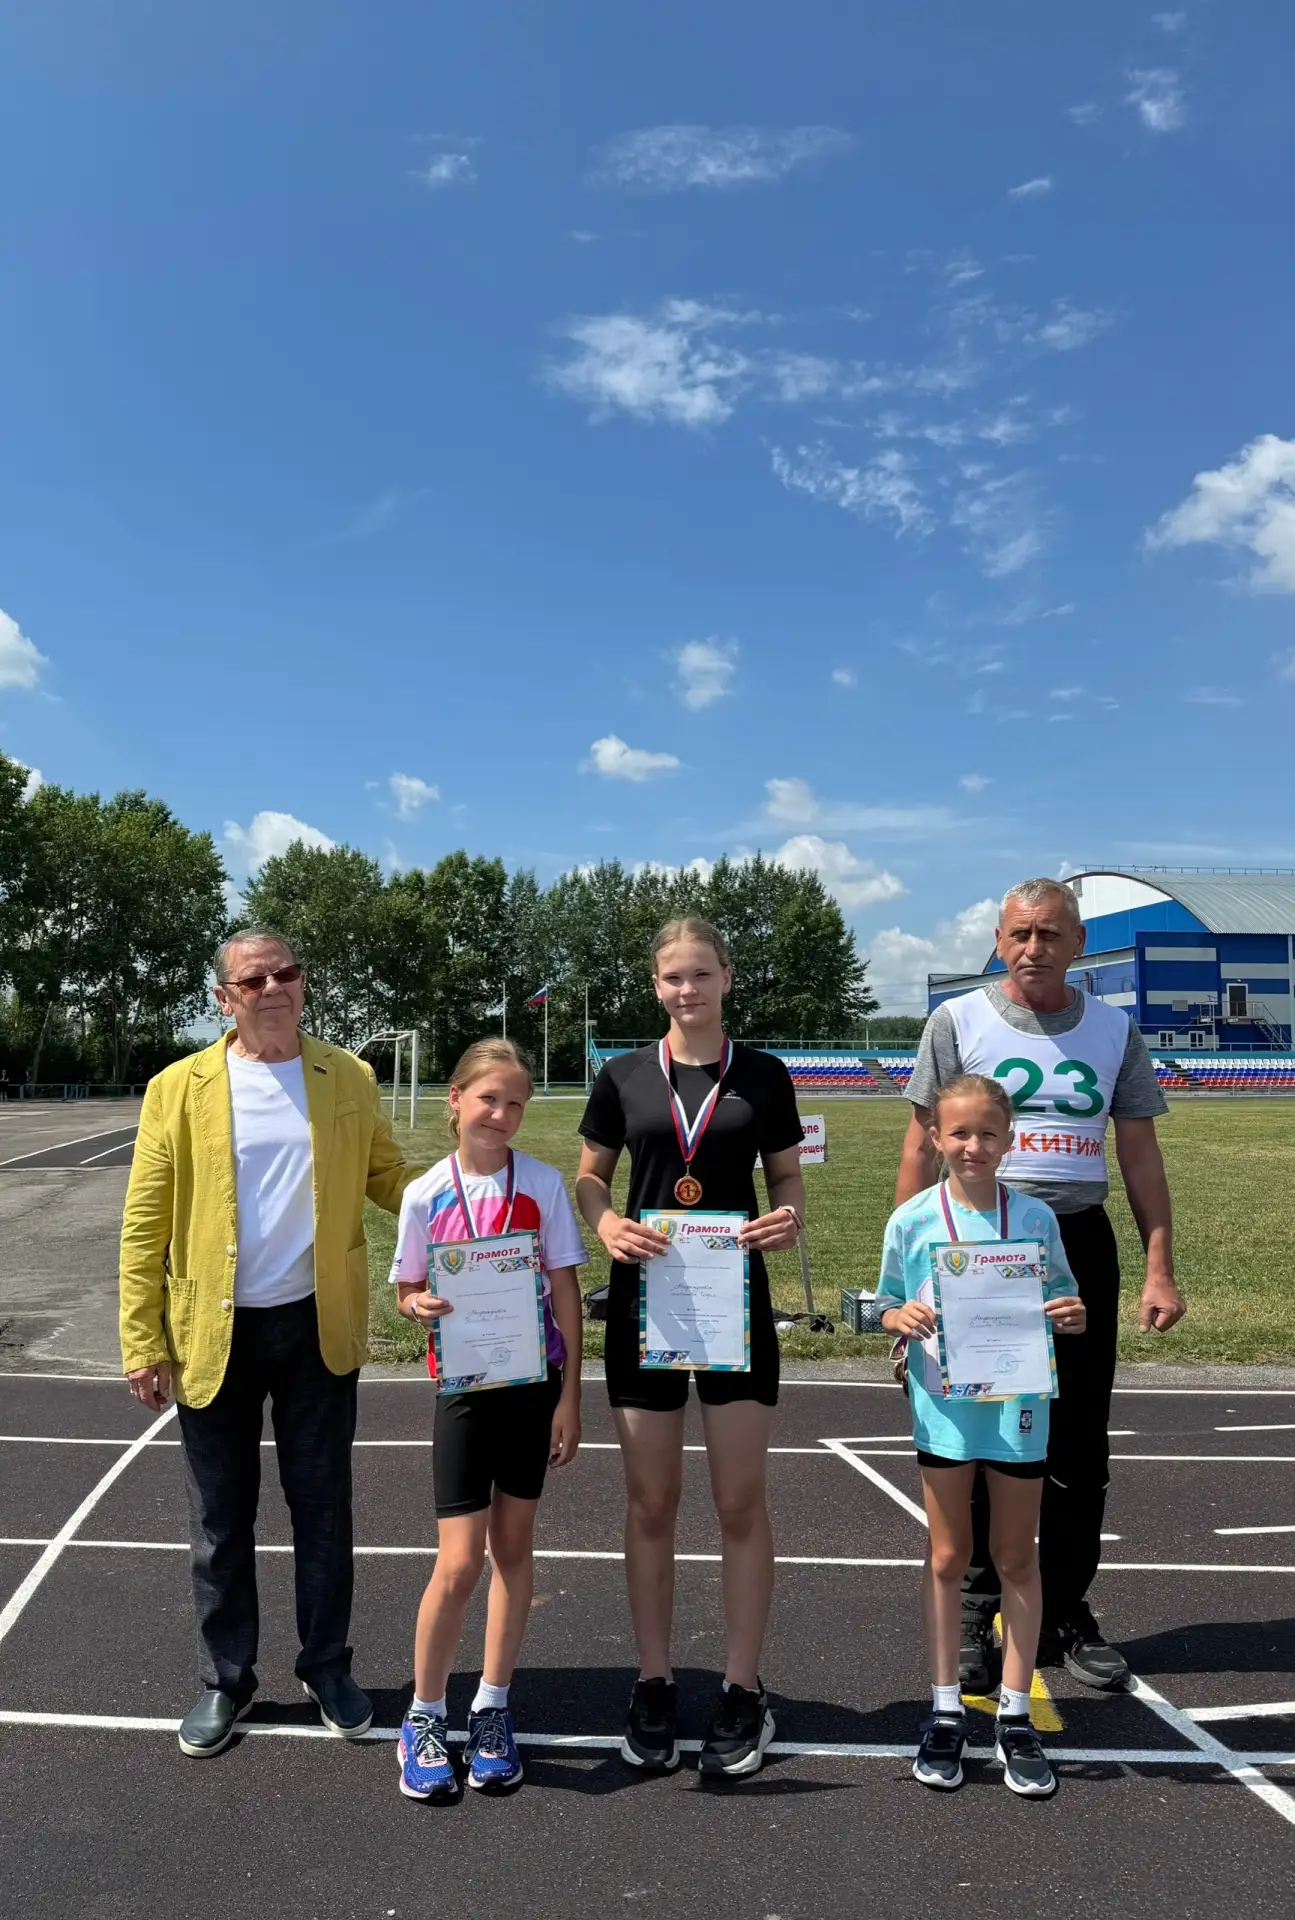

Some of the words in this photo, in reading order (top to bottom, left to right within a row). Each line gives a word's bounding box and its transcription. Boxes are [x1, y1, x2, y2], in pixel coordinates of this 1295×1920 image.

[993, 1057, 1104, 1118] 23
[801, 1124, 819, 1135] оле
[1010, 1132, 1101, 1157] КИТИМ
[681, 1223, 731, 1235] Грамота
[470, 1247, 521, 1262] Грамота
[974, 1254, 1026, 1265] Грамота
